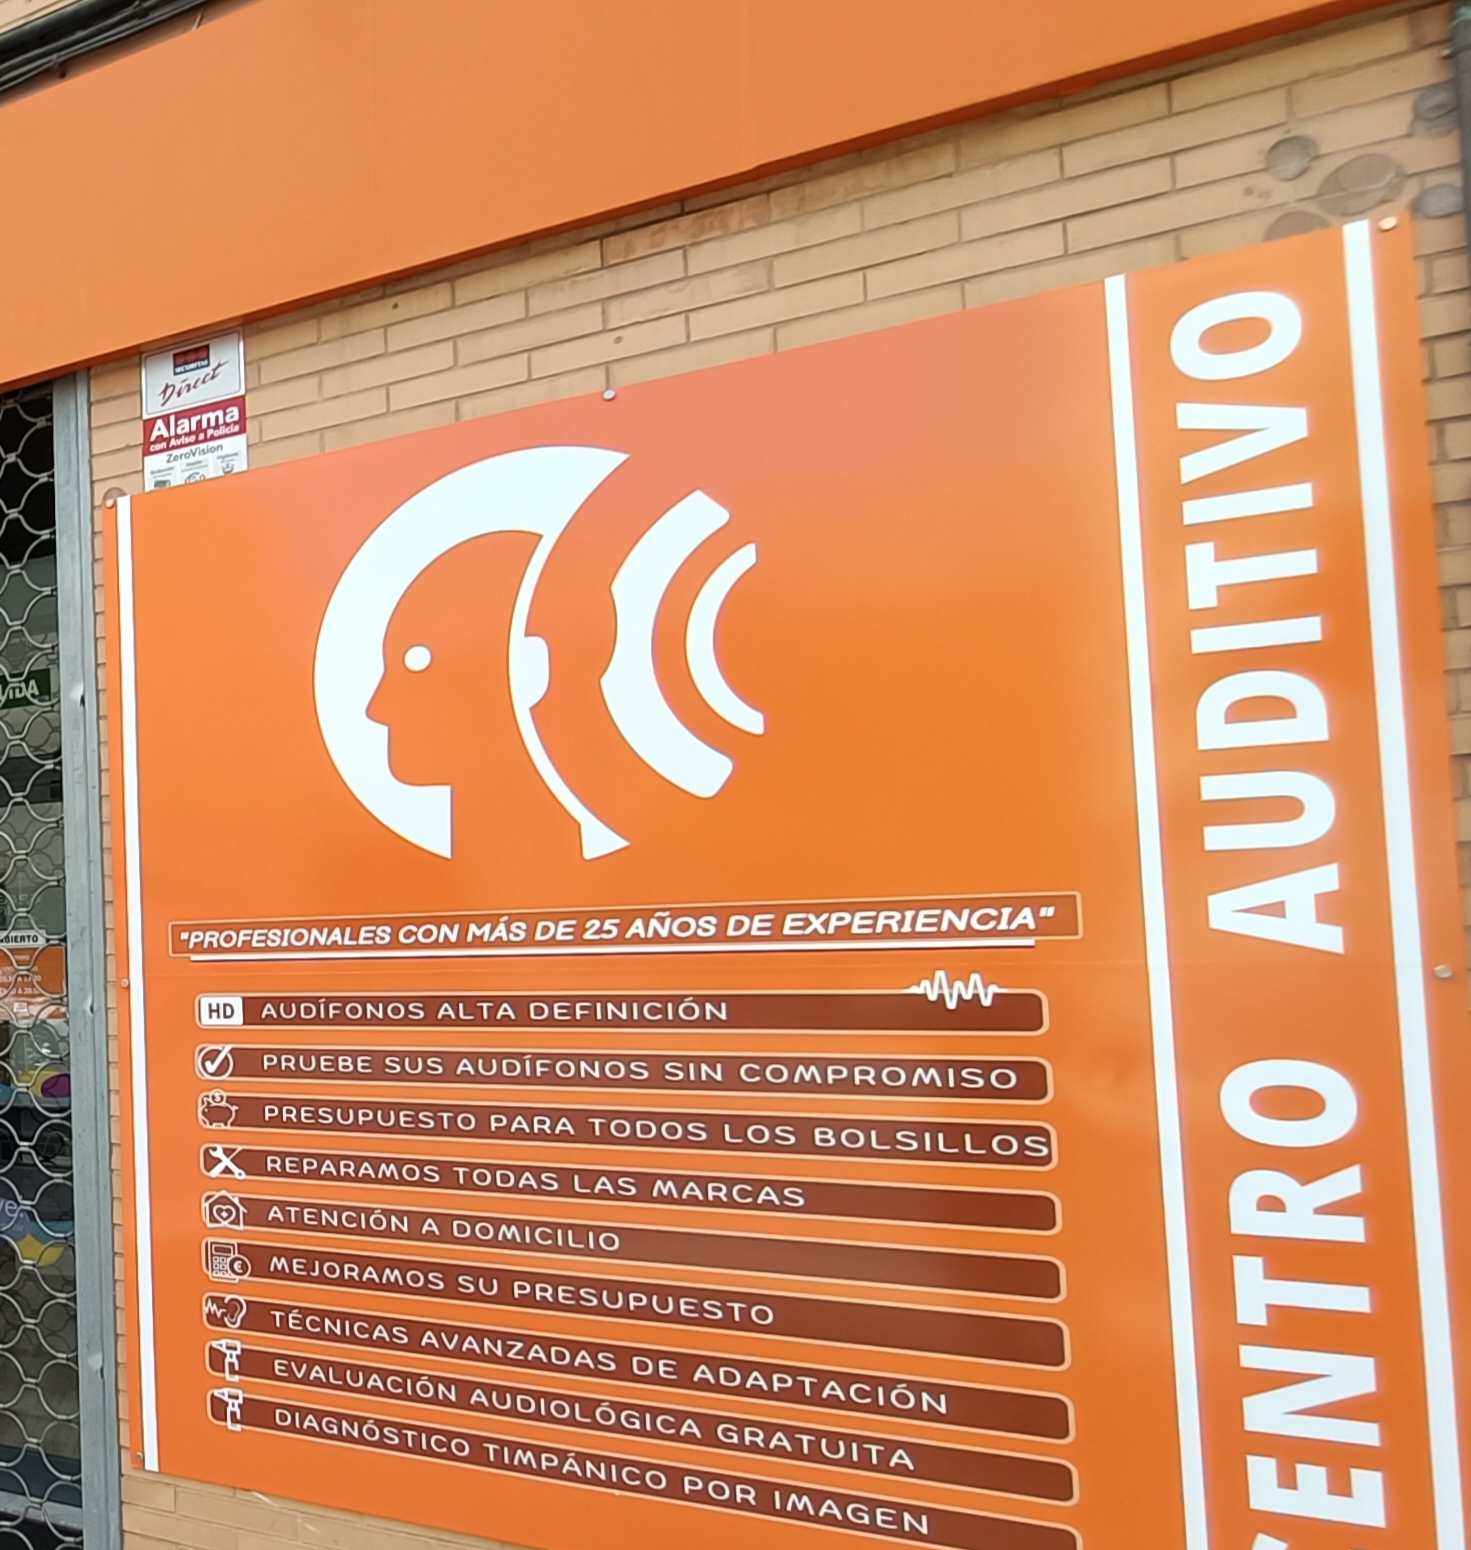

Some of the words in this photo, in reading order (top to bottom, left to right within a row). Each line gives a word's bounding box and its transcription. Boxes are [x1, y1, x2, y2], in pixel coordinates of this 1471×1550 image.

[158, 359, 230, 407] Direct
[149, 405, 240, 443] Alarma
[149, 442, 167, 453] con
[168, 434, 196, 449] Aviso
[197, 432, 205, 441] a
[166, 442, 224, 465] ZeroVision
[1170, 289, 1345, 956] AUDITIVO
[179, 924, 392, 949] "PROFESIONALES
[397, 923, 460, 945] CON
[465, 915, 528, 943] MÁS
[533, 918, 578, 941] DE
[581, 917, 621, 941] 25
[623, 910, 719, 940] AÑOS
[725, 912, 776, 938] DE
[781, 905, 1056, 936] EXPERIENCIA"
[207, 1001, 236, 1021] HD
[261, 998, 426, 1020] AUDÍFONOS
[436, 1001, 517, 1021] ALTA
[528, 996, 728, 1022] DEFINICIÓN
[262, 1054, 373, 1074] PRUEBE
[384, 1056, 444, 1075] SUS
[455, 1053, 650, 1081] AUDÍFONOS
[663, 1061, 724, 1083] SIN
[738, 1063, 1018, 1090] COMPROMISO
[263, 1104, 477, 1132] PRESUPUESTO
[489, 1113, 576, 1136] PARA
[587, 1117, 708, 1142] TODOS
[723, 1122, 797, 1146] LOS
[813, 1126, 1050, 1158] BOLSILLOS
[265, 1154, 441, 1184] REPARAMOS
[452, 1166, 560, 1192] TODAS
[573, 1173, 639, 1197] LAS
[651, 1178, 806, 1208] MARCAS
[267, 1204, 409, 1234] ATENCIÓN
[420, 1217, 441, 1237] A
[451, 1219, 621, 1252] DOMICILIO
[269, 1256, 445, 1291] MEJORAMOS
[457, 1275, 500, 1297] SU
[512, 1280, 776, 1326] PRESUPUESTO
[1218, 1056, 1388, 1550] ENTRO
[269, 1308, 410, 1345] TÉCNICAS
[420, 1329, 617, 1372] AVANZADAS
[631, 1356, 679, 1380] DE
[692, 1364, 948, 1415] ADAPTACIÓN
[273, 1359, 457, 1403] EVALUACIÓN
[469, 1388, 703, 1438] AUDIOLÓGICA
[716, 1422, 919, 1471] GRATUITA
[274, 1408, 471, 1461] DIAGNÓSTICO
[482, 1443, 668, 1492] TIMPÁNICO
[682, 1475, 758, 1506] POR
[773, 1489, 930, 1535] IMAGEN
